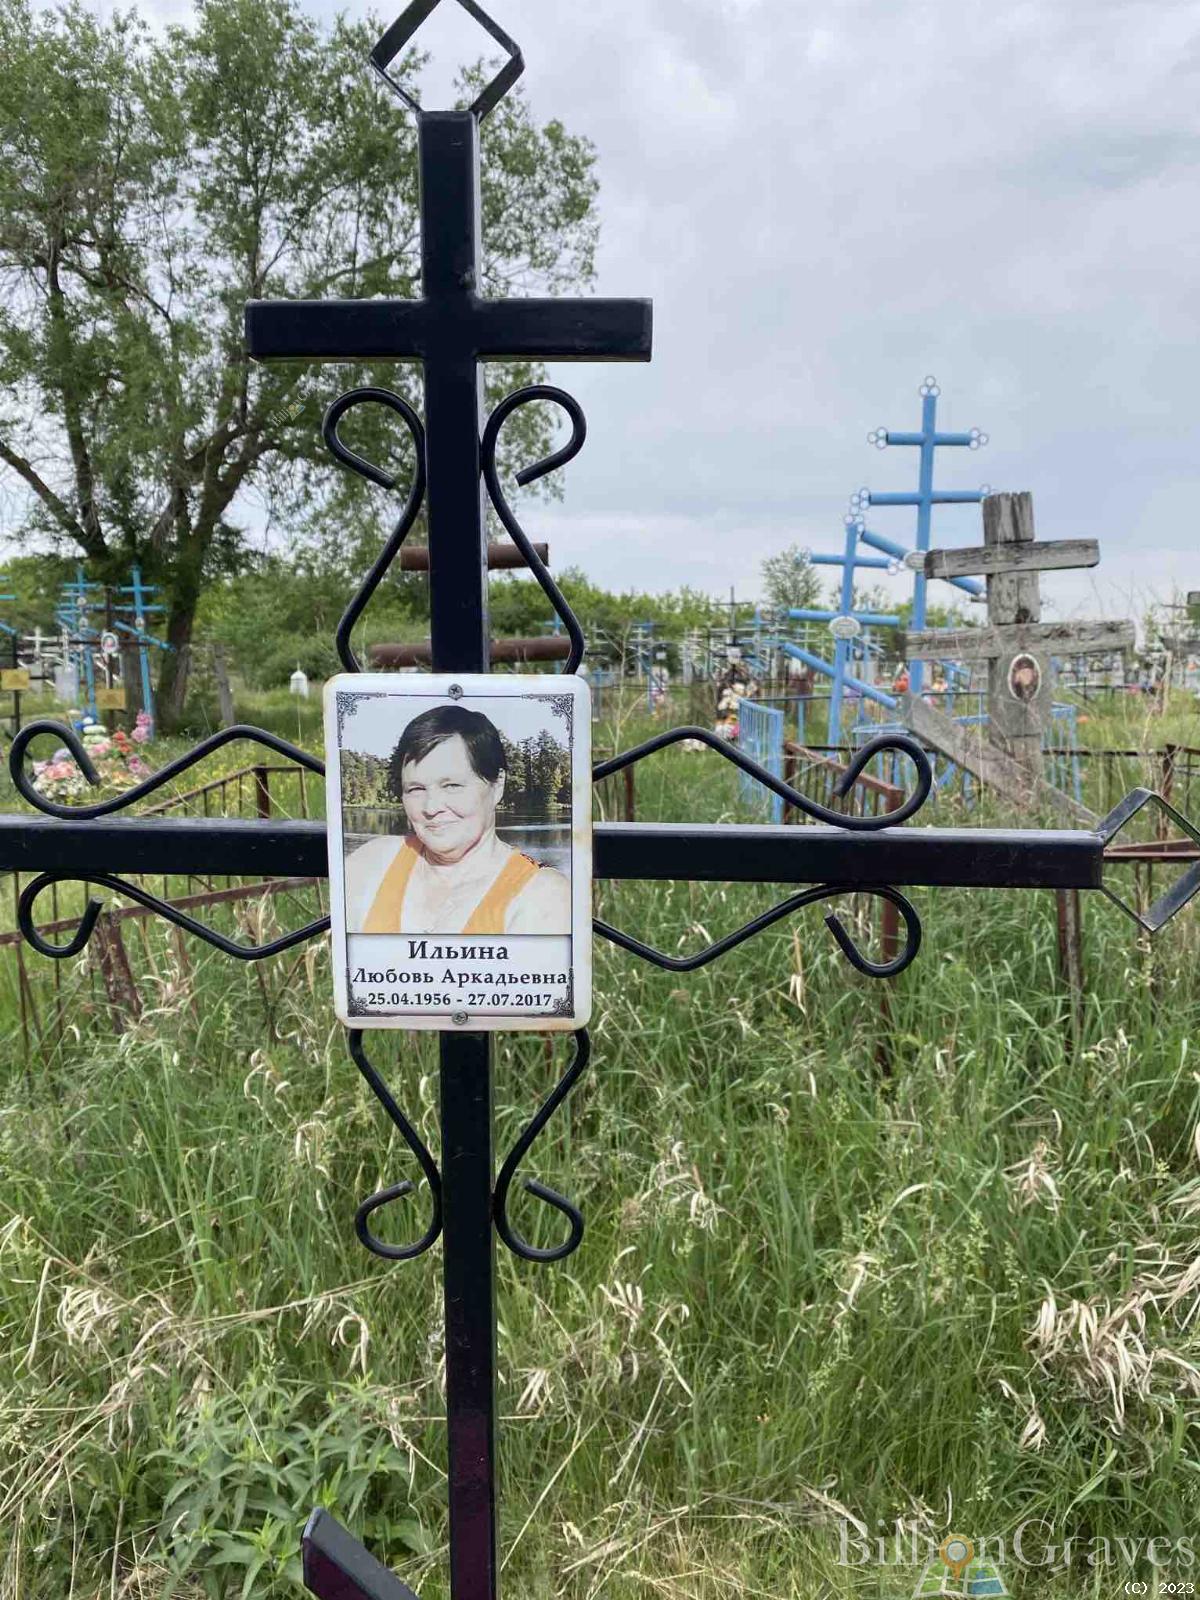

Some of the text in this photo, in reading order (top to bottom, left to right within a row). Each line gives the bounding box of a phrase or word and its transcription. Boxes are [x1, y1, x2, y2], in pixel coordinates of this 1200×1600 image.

[407, 940, 509, 960] Ильина
[352, 967, 567, 988] Любовь Аркадьевна
[367, 992, 451, 1006] 25.04.1956
[468, 993, 552, 1006] 27.07.2017
